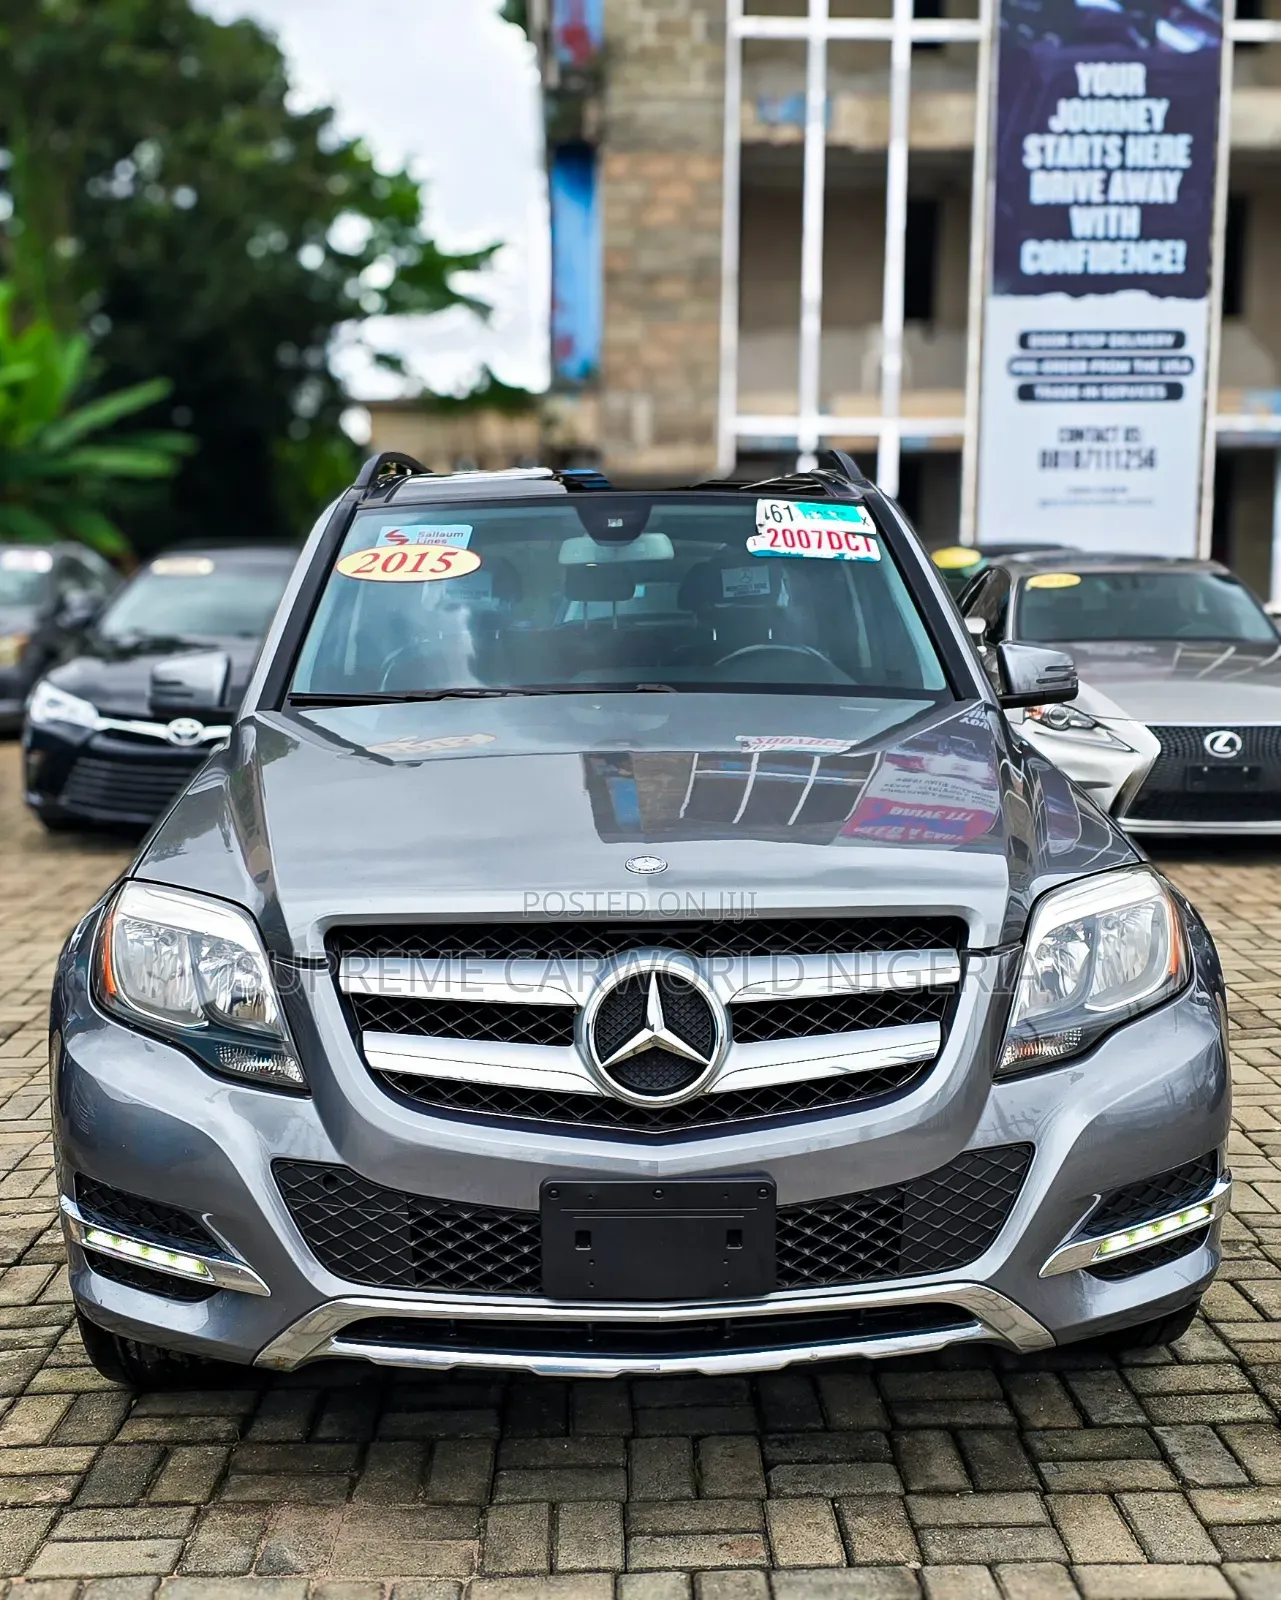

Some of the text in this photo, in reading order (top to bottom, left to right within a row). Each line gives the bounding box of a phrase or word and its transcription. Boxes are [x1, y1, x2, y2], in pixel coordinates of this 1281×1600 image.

[1074, 62, 1147, 97] YOUR
[1048, 98, 1170, 133] JOURNEY
[1022, 133, 1193, 169] STARTS HERE
[1029, 169, 1183, 204] DRIVE AWAY
[1069, 204, 1141, 239] WITH
[1020, 239, 1187, 275] CONFIDENCE!
[417, 530, 464, 538] Sallaum
[351, 552, 458, 574] 2015
